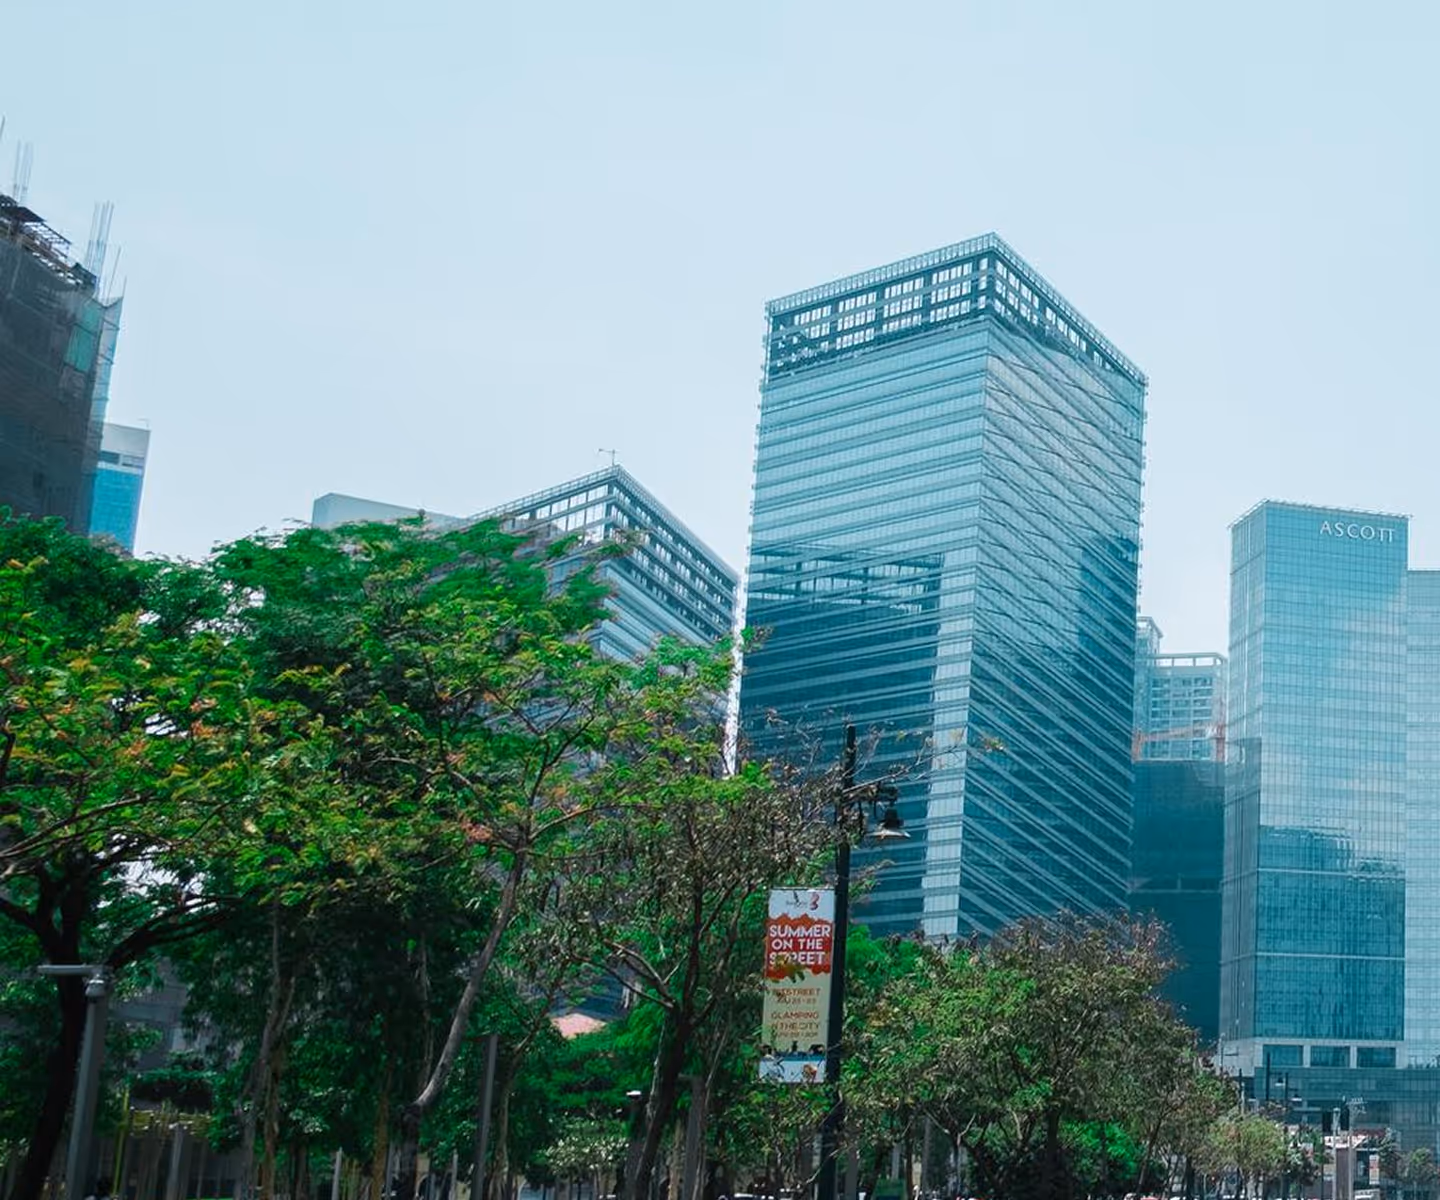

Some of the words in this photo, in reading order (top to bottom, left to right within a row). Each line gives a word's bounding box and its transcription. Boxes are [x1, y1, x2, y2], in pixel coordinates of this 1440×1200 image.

[1319, 520, 1395, 543] ASCOTT
[769, 925, 831, 938] SUMMER
[771, 939, 793, 951] ON
[797, 938, 824, 950] THE
